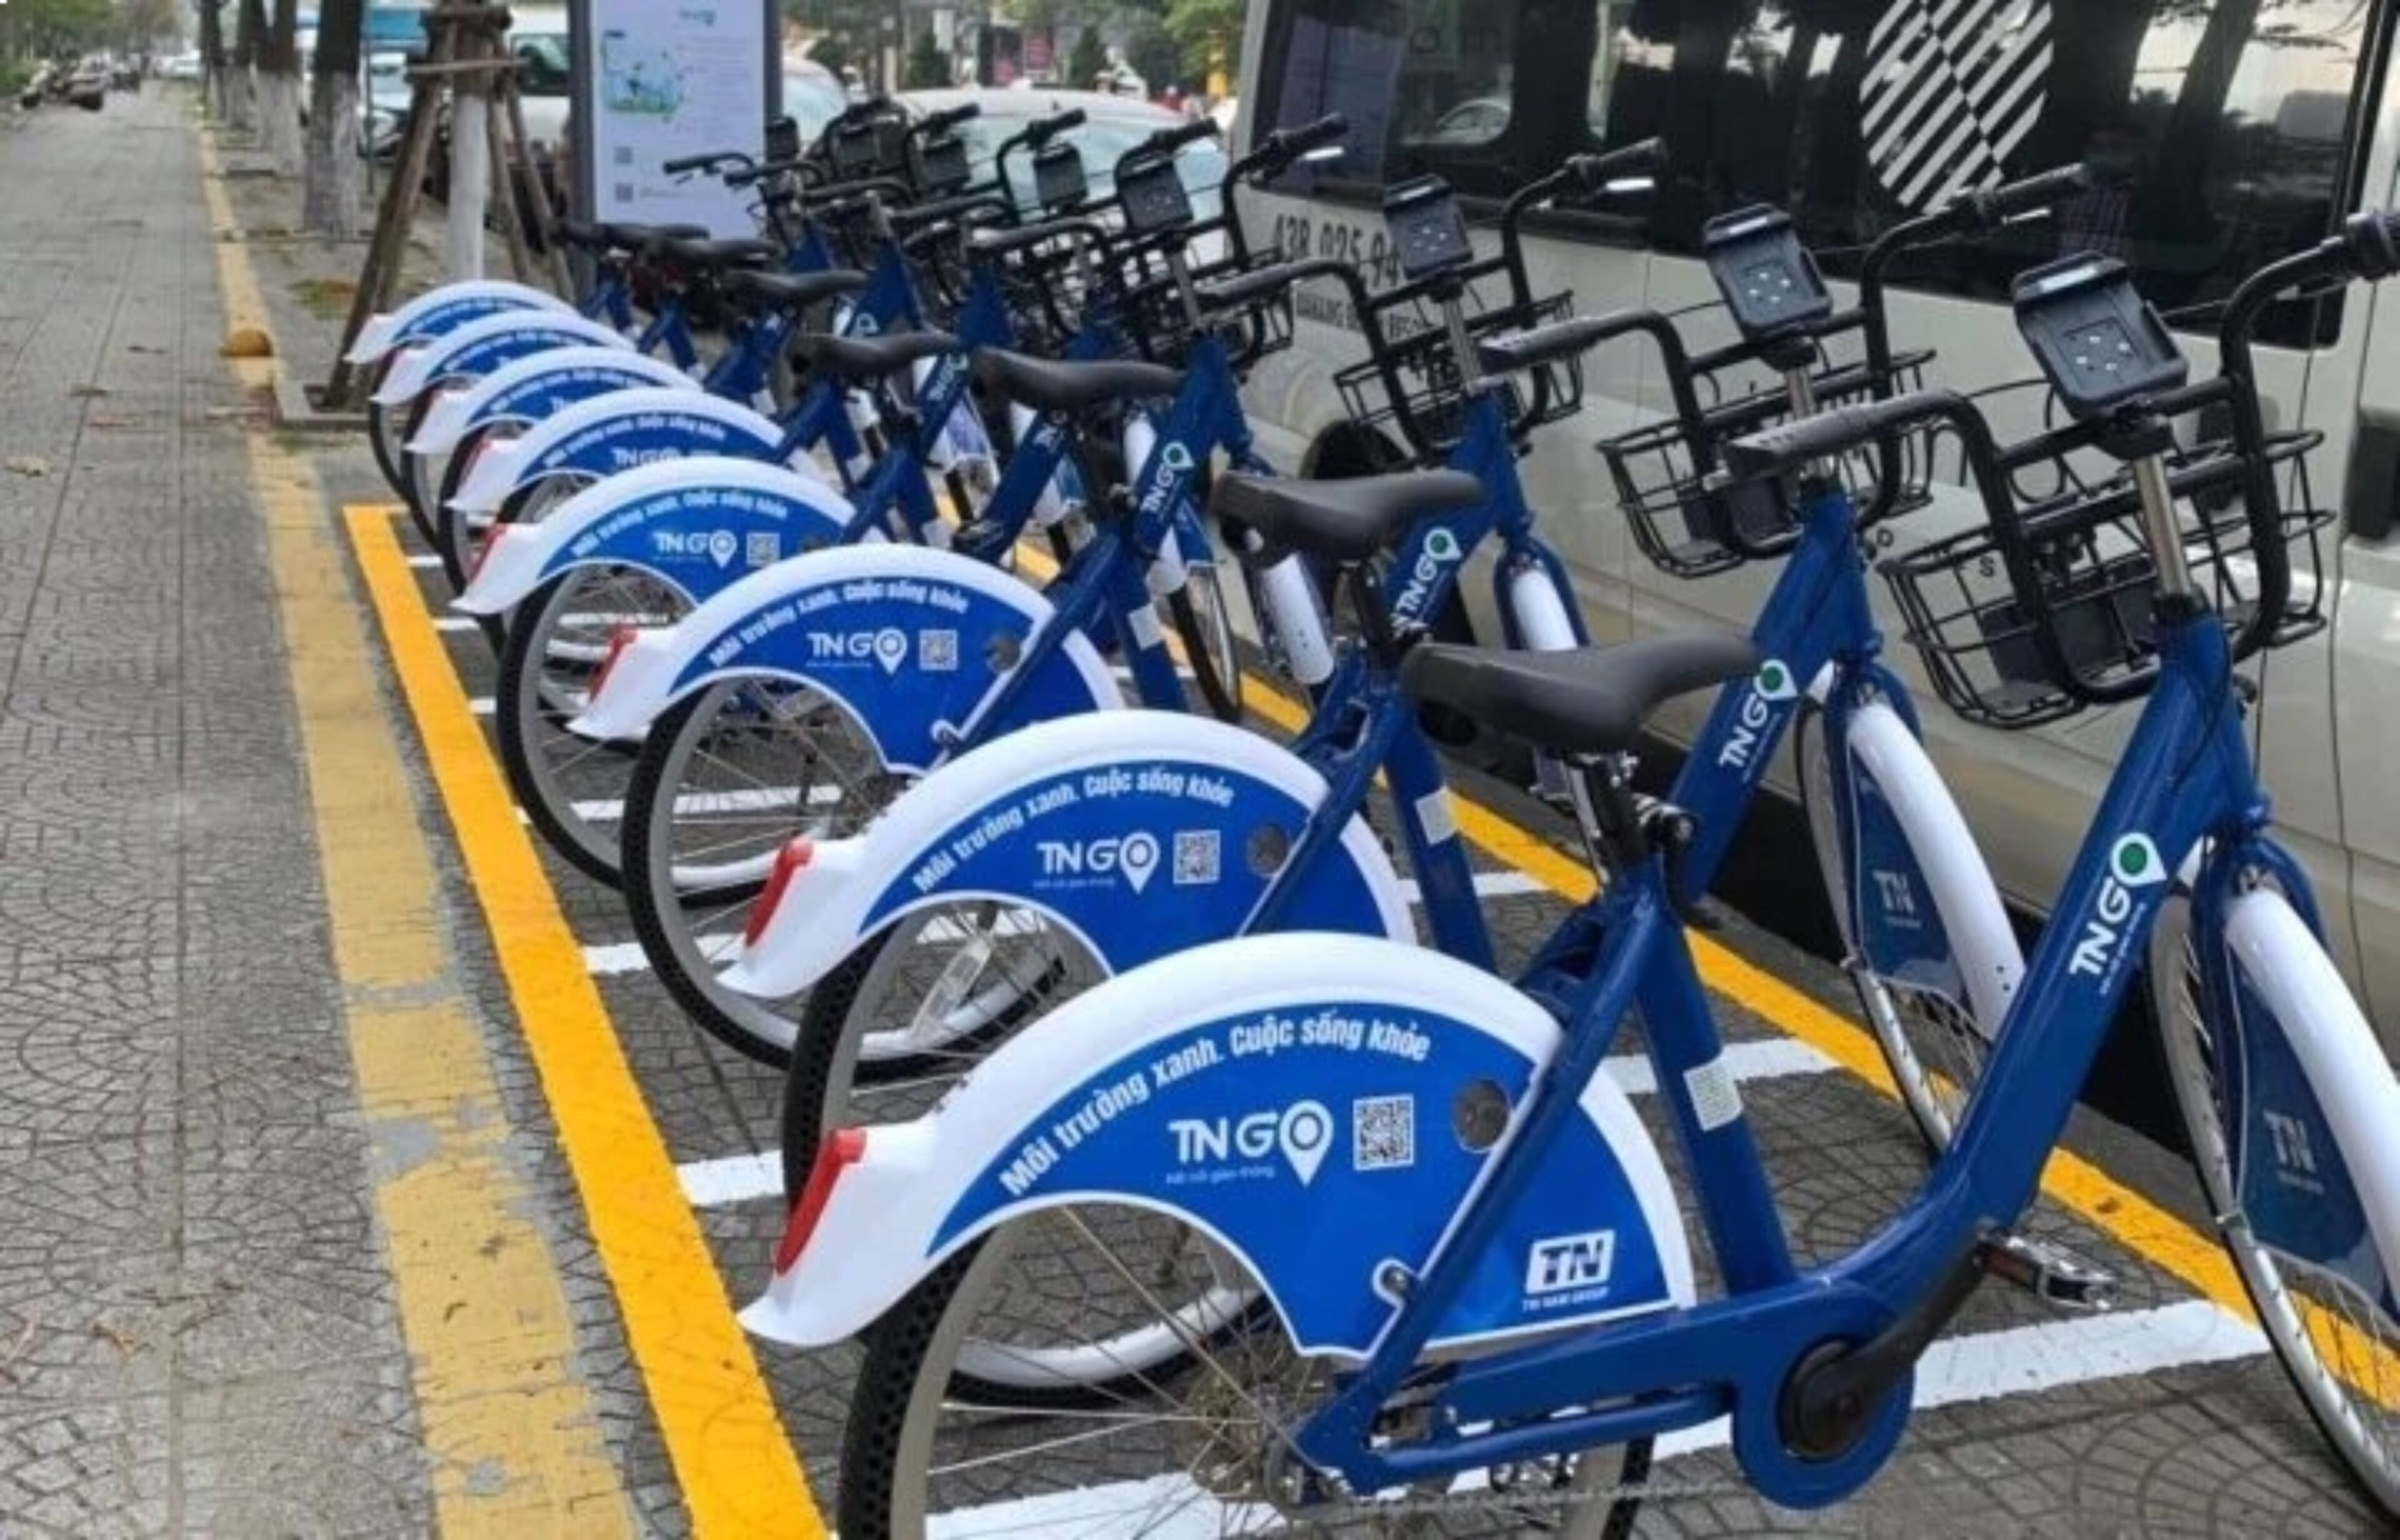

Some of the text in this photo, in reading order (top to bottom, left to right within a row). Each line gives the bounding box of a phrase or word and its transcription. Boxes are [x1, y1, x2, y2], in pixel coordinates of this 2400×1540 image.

[912, 849, 956, 892] Môi
[952, 806, 1024, 860] trường
[1083, 766, 1132, 799] Cuộc
[1136, 765, 1184, 798] sống
[1000, 1134, 1061, 1196] Môi
[1053, 1072, 1151, 1149] trường
[1229, 1013, 1294, 1058] Cuộc
[1300, 1007, 1365, 1051] sống
[1367, 1018, 1431, 1062] khỏe
[1538, 1237, 1606, 1284] TN
